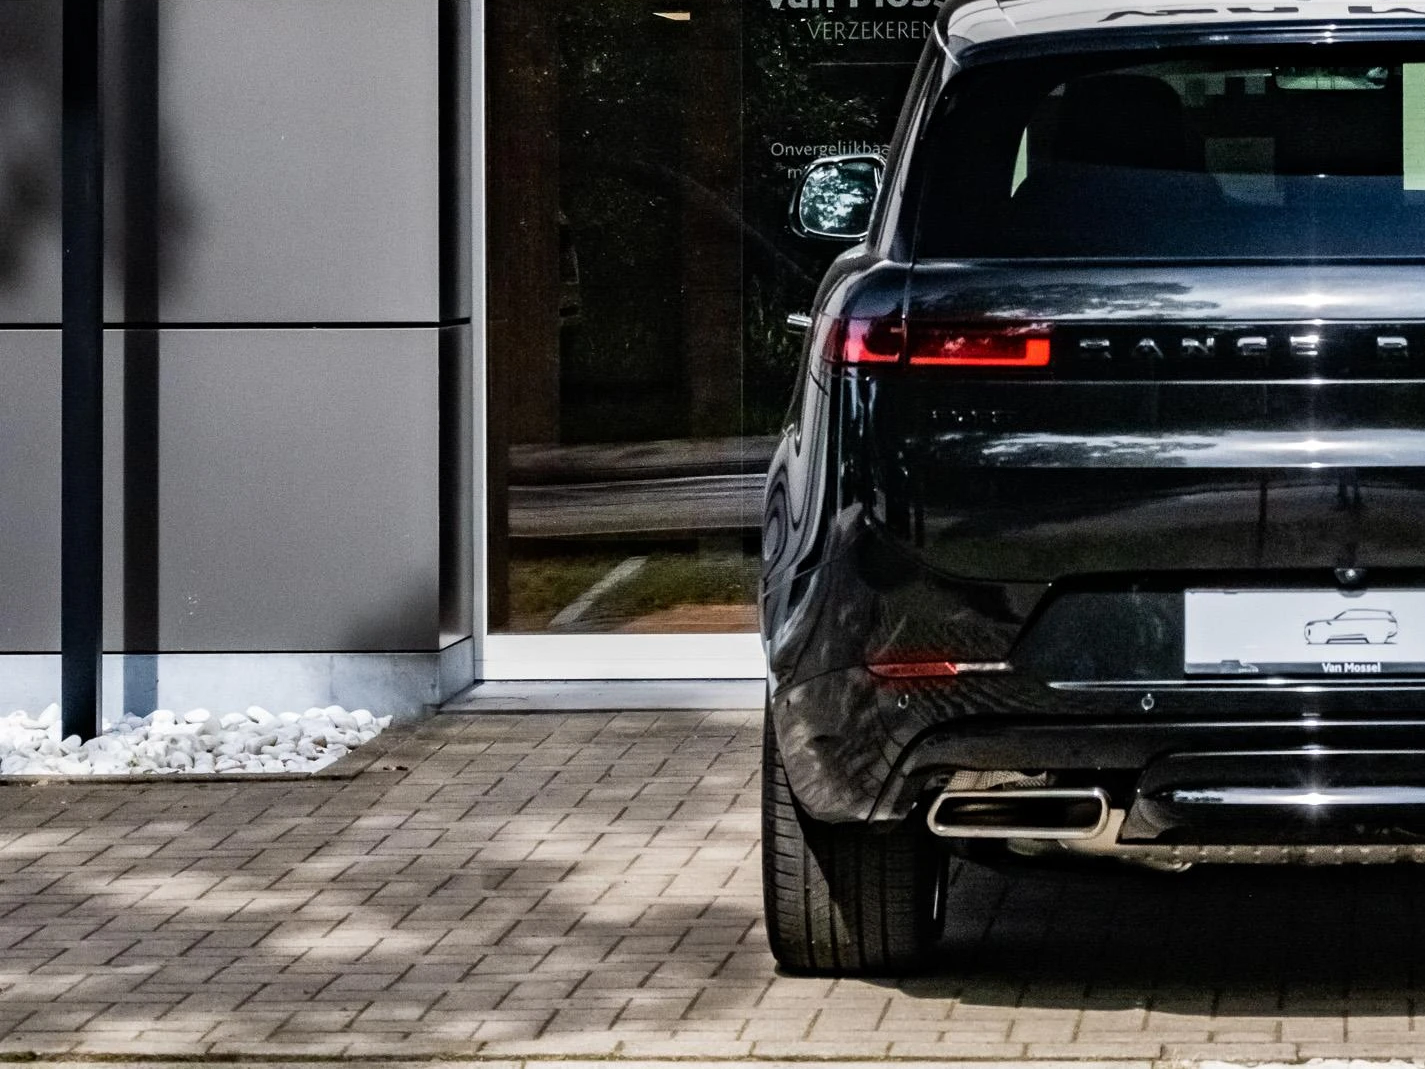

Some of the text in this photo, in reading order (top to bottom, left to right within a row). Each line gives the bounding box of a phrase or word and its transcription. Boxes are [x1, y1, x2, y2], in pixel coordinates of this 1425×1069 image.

[771, 140, 891, 159] Onvergelijkbaa
[1079, 335, 1319, 359] RANGE
[1321, 662, 1381, 673] Van Mossel
